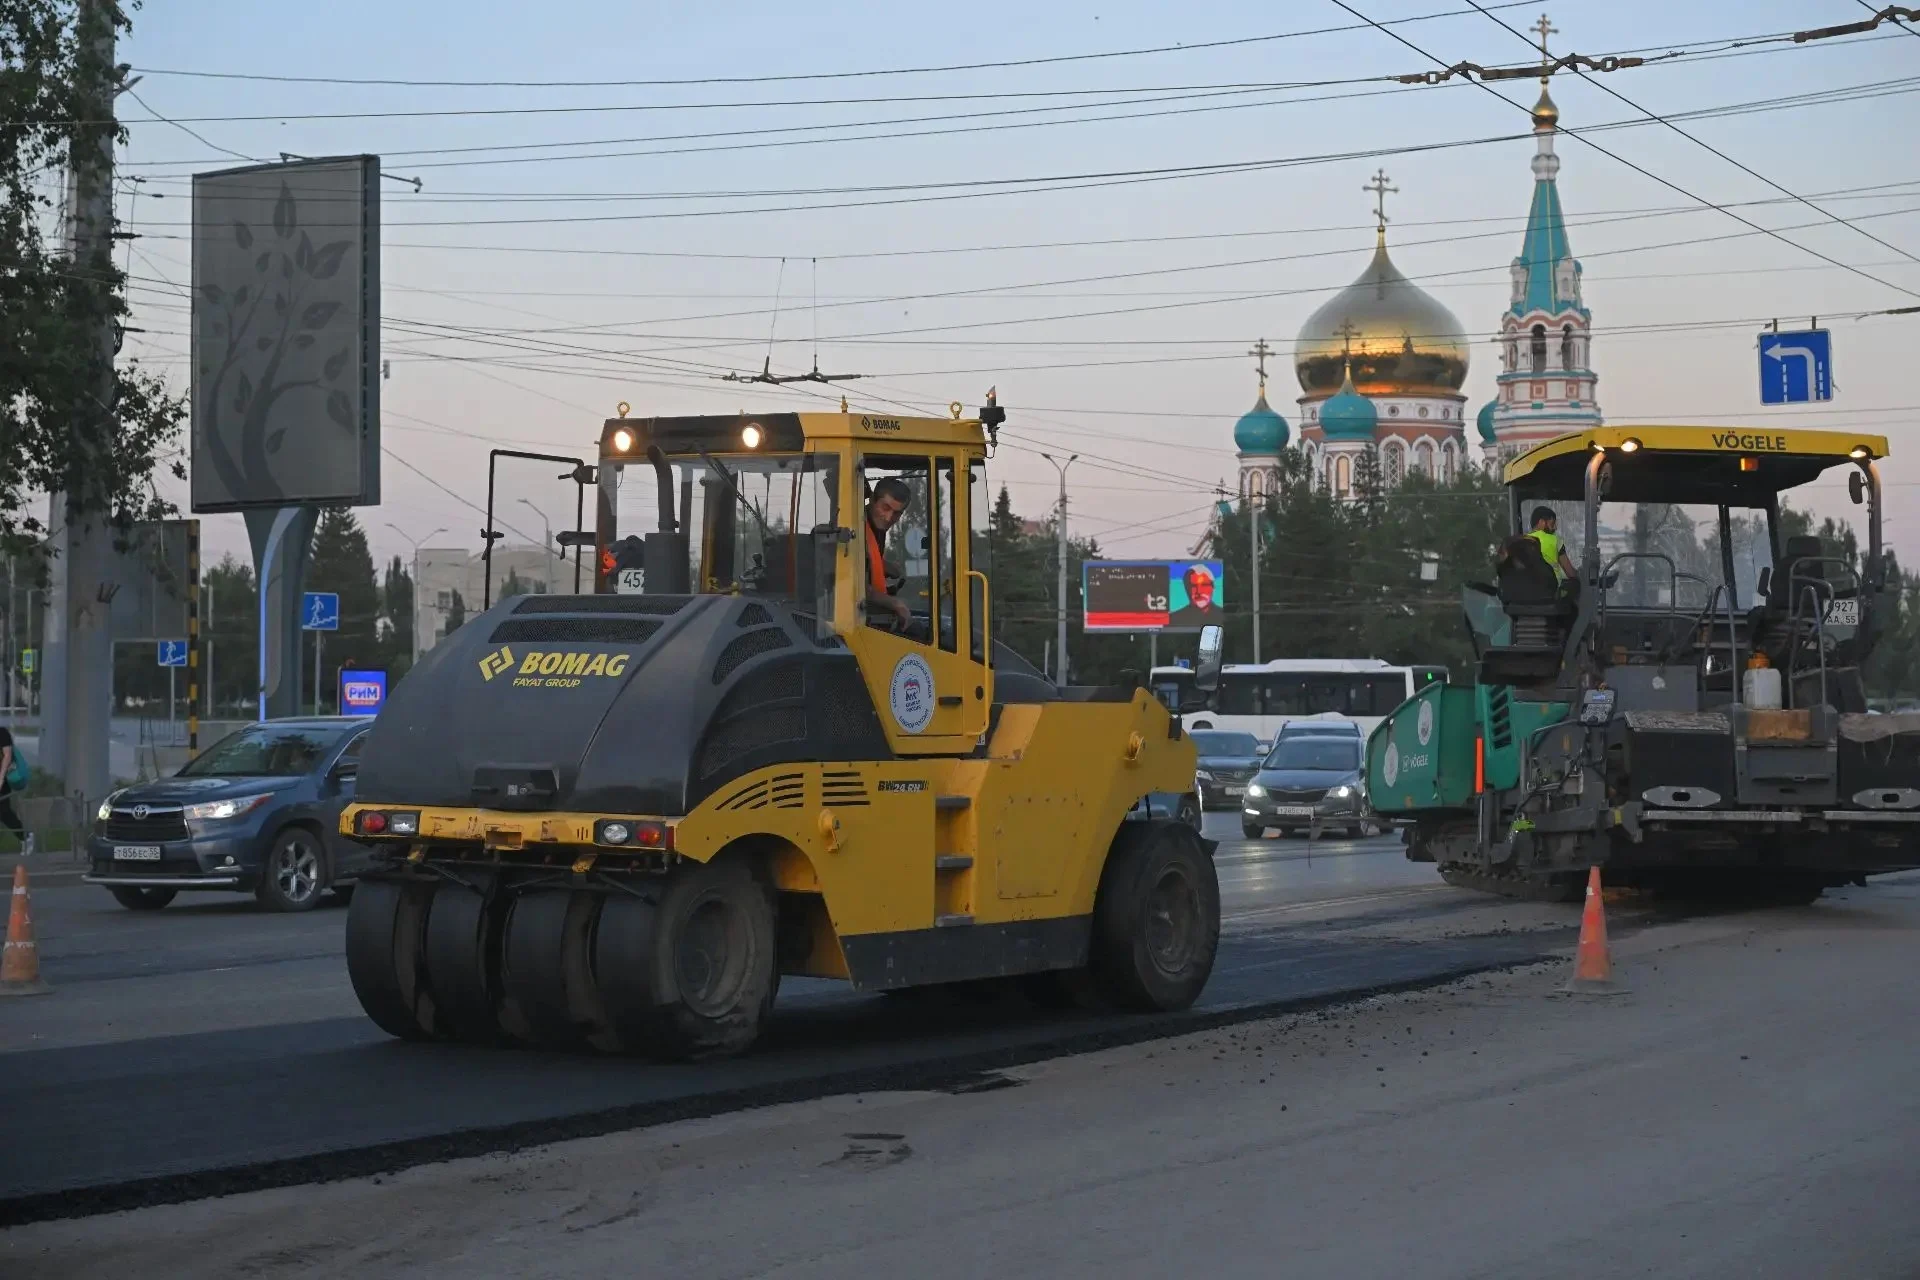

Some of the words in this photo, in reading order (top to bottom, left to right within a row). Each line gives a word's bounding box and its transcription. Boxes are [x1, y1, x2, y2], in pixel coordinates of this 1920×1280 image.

[873, 419, 901, 431] BOMAG
[1711, 430, 1787, 451] VÖGELE
[1147, 593, 1167, 610] t2
[1845, 615, 1856, 624] 55
[518, 652, 630, 677] BOMAG
[512, 677, 544, 687] FAYAT
[545, 678, 581, 688] GROUP
[349, 686, 378, 699] РИМ
